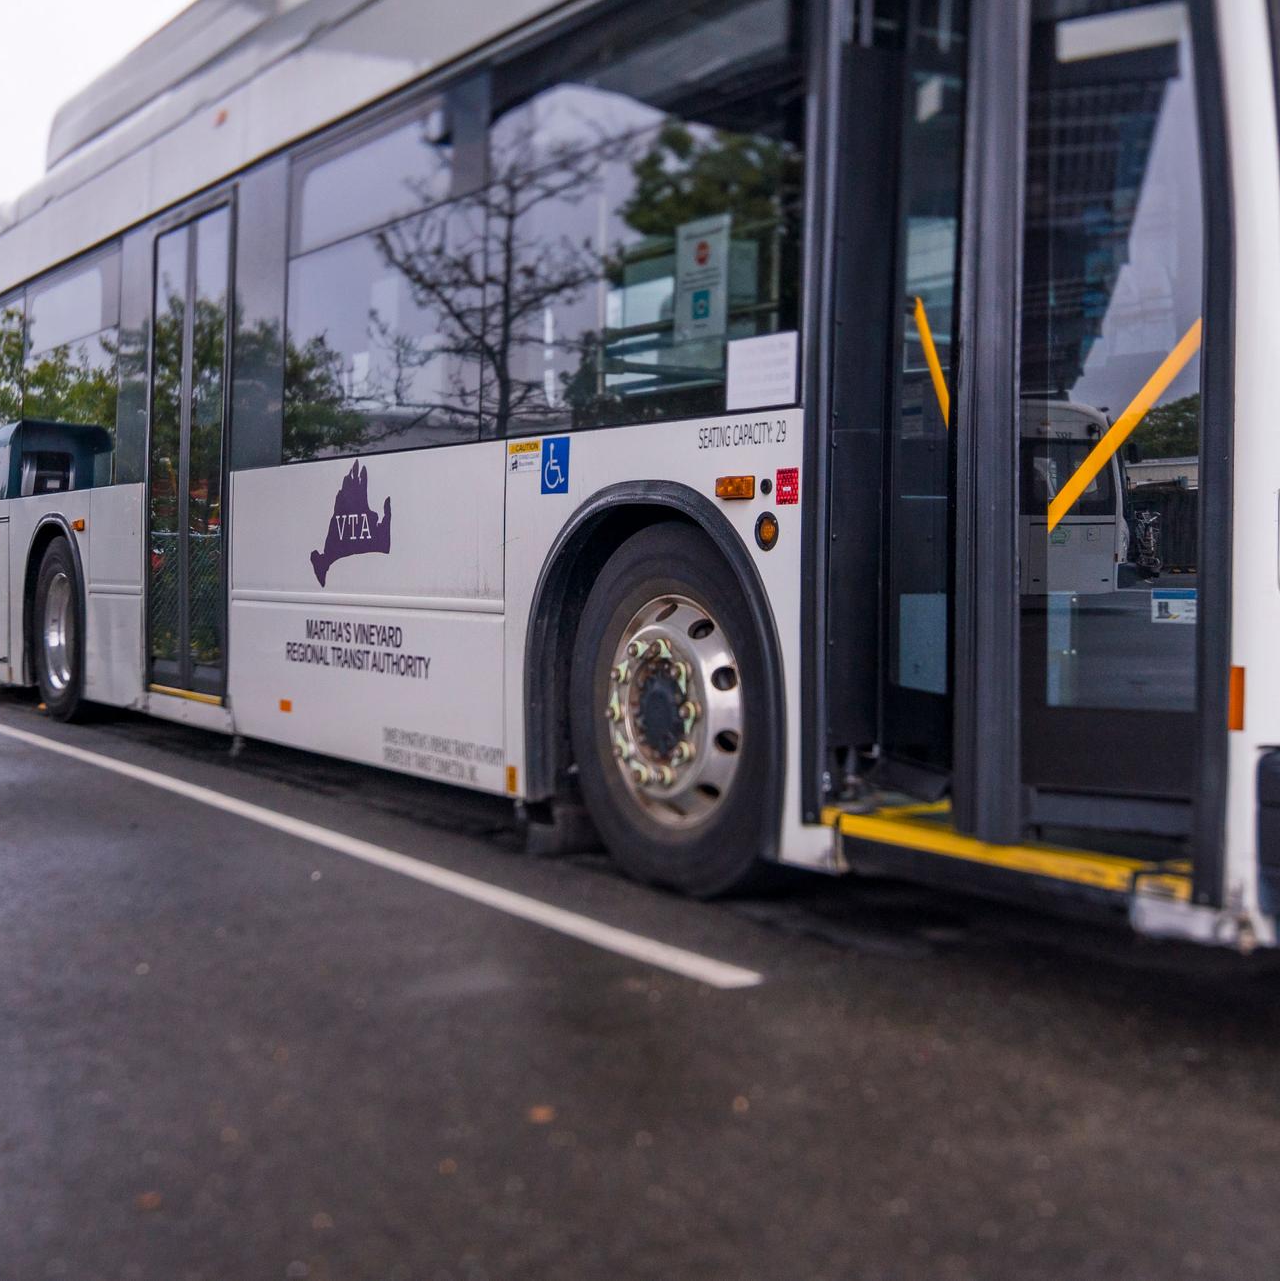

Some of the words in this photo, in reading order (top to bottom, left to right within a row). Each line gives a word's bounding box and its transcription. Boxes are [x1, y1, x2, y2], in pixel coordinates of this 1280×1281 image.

[515, 441, 539, 452] CAUTION
[699, 425, 731, 449] SEATING
[776, 420, 786, 443] 29
[335, 513, 372, 541] VTA
[306, 619, 352, 644] MARTHA'S
[353, 623, 403, 649] VINEYARD
[285, 642, 330, 666] REGIONAL
[331, 646, 371, 671] TRANSIT
[370, 651, 431, 680] AUTHORITY
